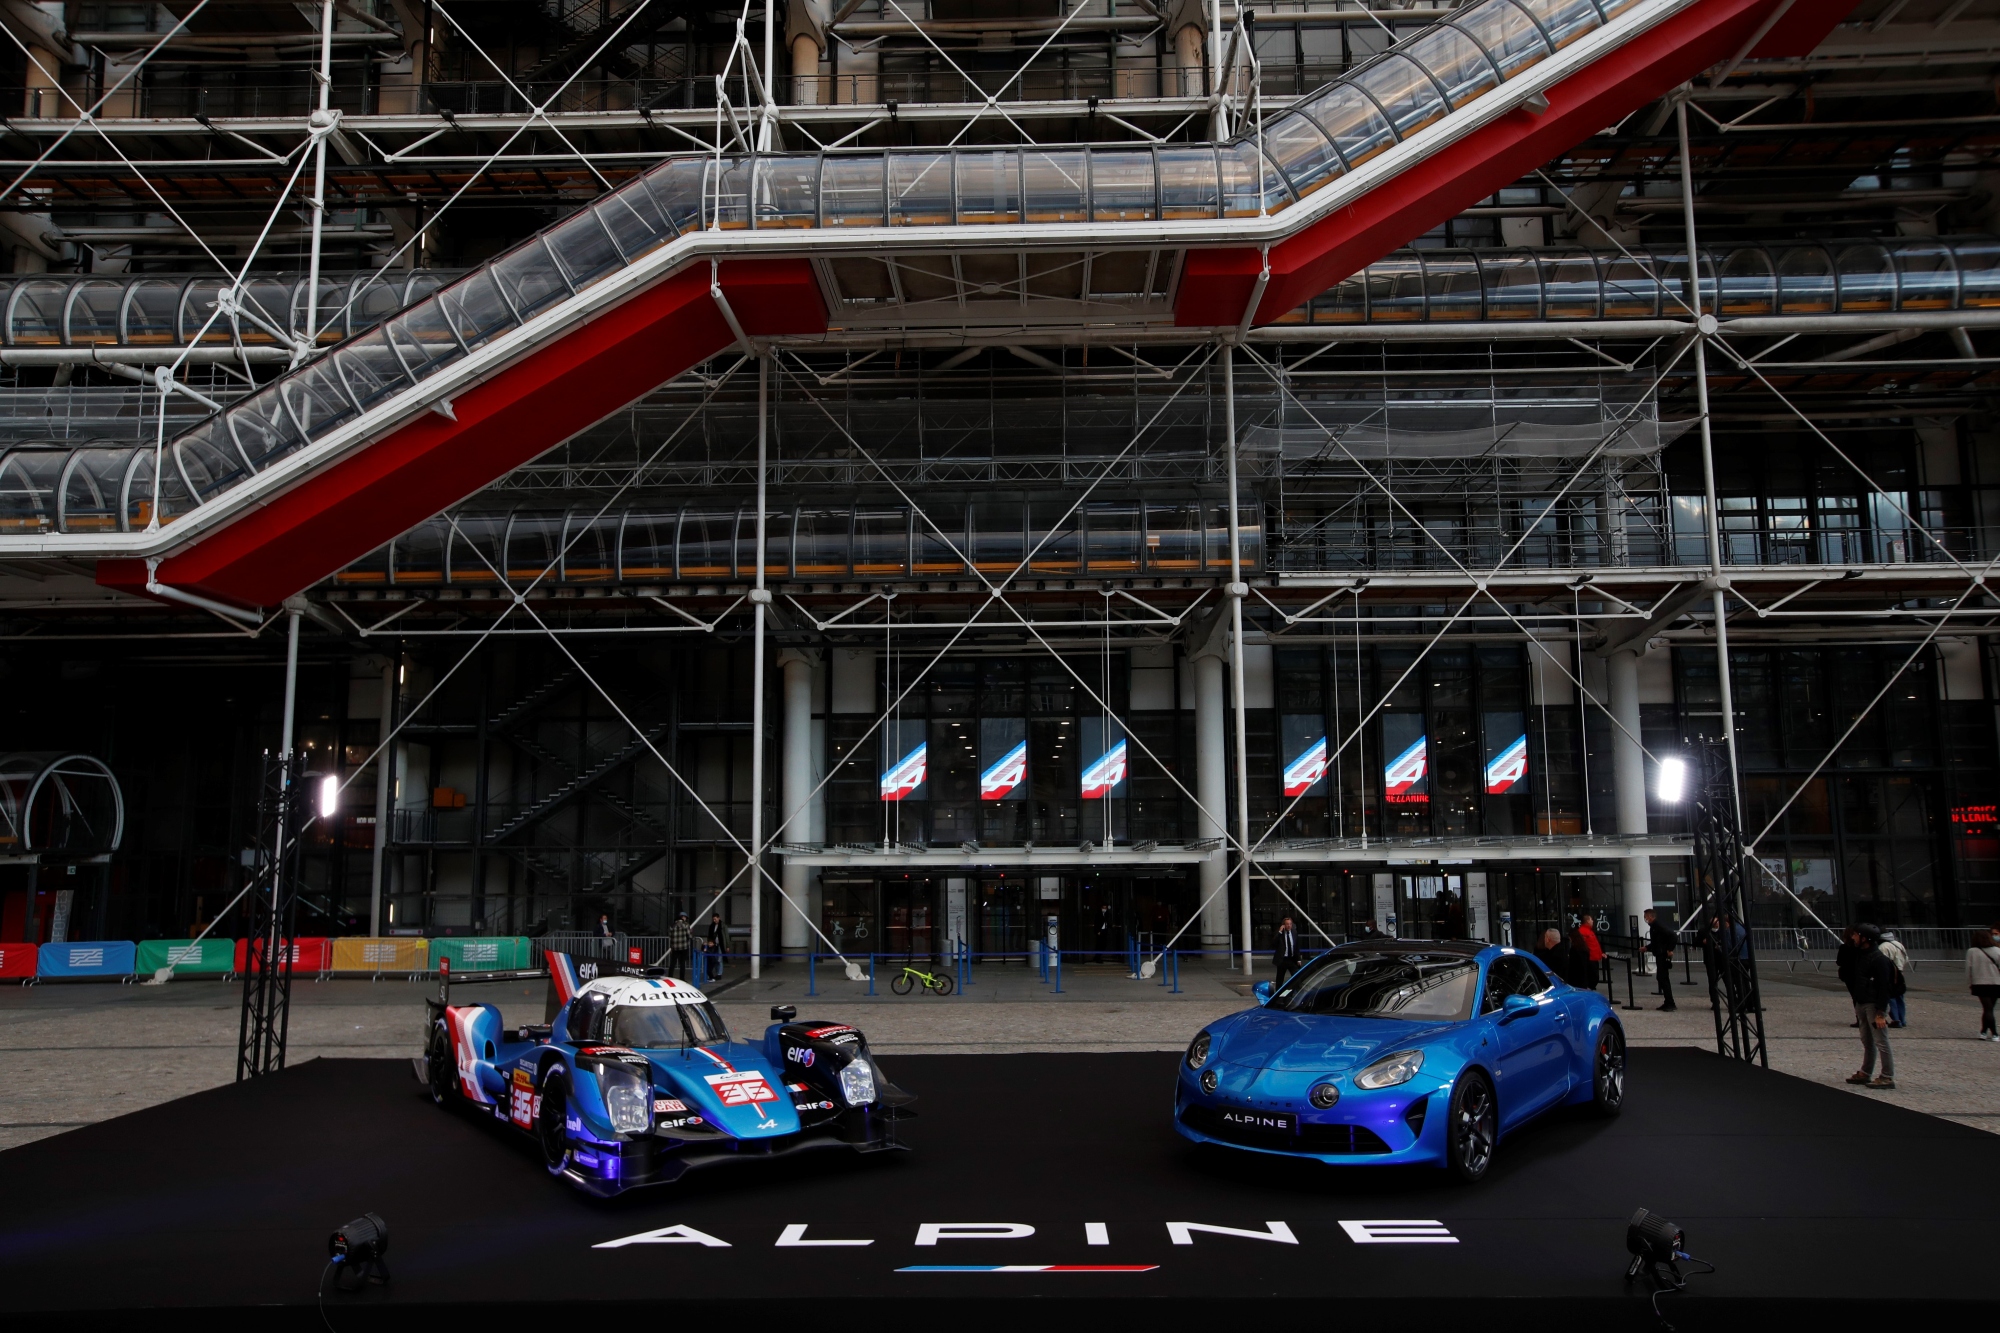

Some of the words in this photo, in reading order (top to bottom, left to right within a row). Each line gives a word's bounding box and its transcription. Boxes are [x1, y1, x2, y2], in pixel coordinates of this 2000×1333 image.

[579, 962, 592, 979] elf
[621, 966, 640, 976] ALPINE
[787, 1047, 804, 1063] elf
[516, 1072, 530, 1084] DHL
[719, 1081, 774, 1104] 36
[514, 1088, 532, 1125] 36
[796, 1102, 819, 1111] elf
[660, 1118, 686, 1129] elf
[1223, 1112, 1288, 1129] ALPINE
[591, 1219, 1460, 1248] ALPINE
